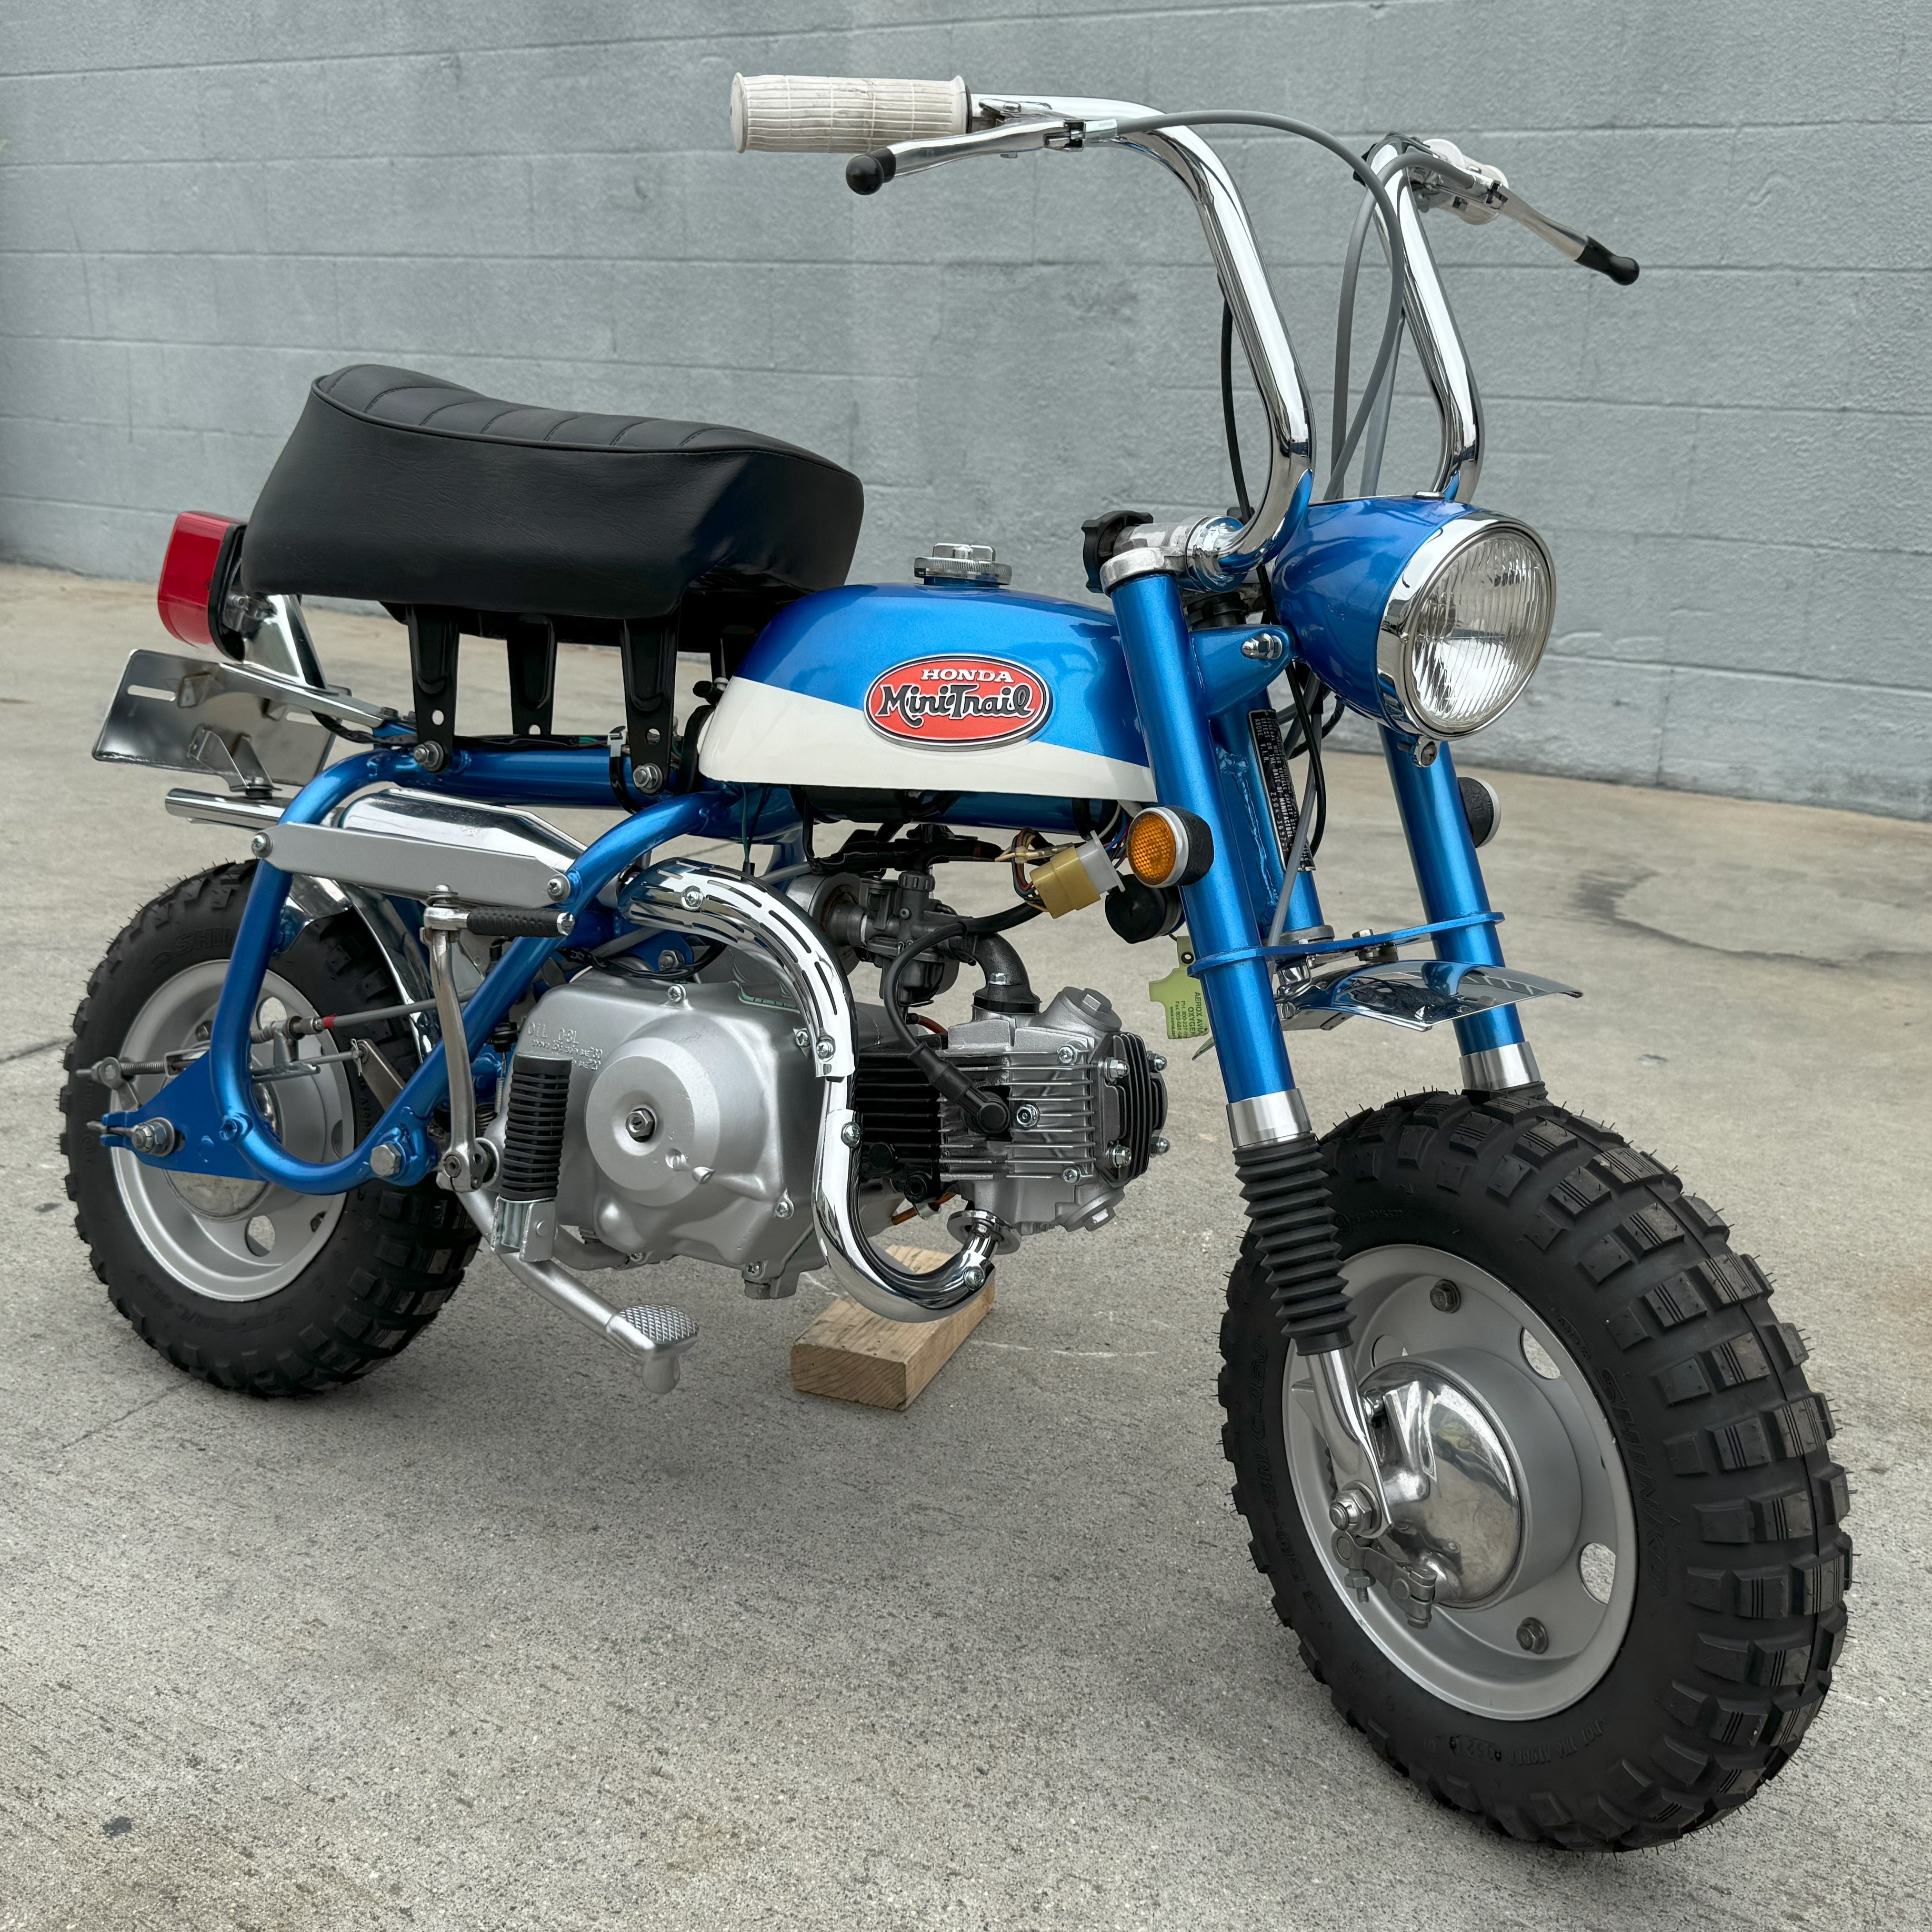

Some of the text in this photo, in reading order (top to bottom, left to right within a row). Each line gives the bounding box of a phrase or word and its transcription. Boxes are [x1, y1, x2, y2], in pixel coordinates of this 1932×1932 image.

[920, 669, 1014, 683] HONDA
[1279, 798, 1293, 837] MANUFACTURE
[528, 1022, 548, 1038] OIL
